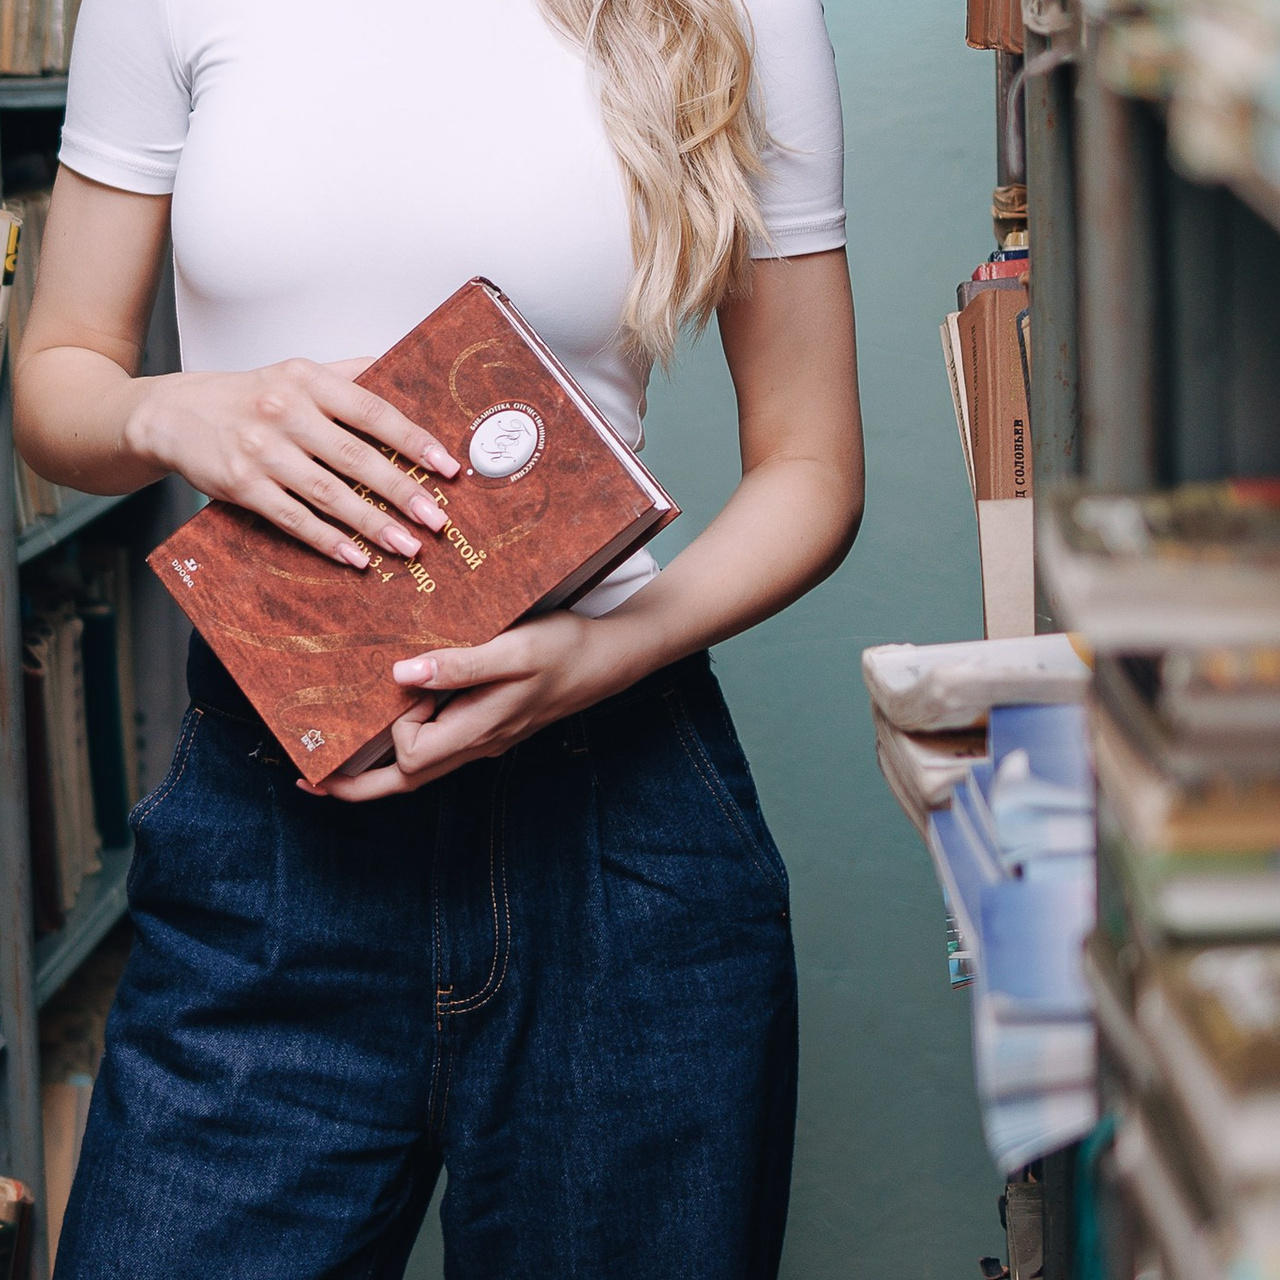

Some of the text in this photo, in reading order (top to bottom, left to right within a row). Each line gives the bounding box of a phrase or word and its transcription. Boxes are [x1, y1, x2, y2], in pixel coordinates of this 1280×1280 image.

[470, 403, 510, 431] БИБЛИОТЕКА
[513, 402, 546, 450] ОТЕЧЕСТВЕННОЙ
[510, 451, 541, 483] КЛАССИКИ
[1014, 419, 1026, 485] СОЛОВЬЕВ
[433, 487, 487, 571] Тлстой
[403, 557, 436, 593] мир
